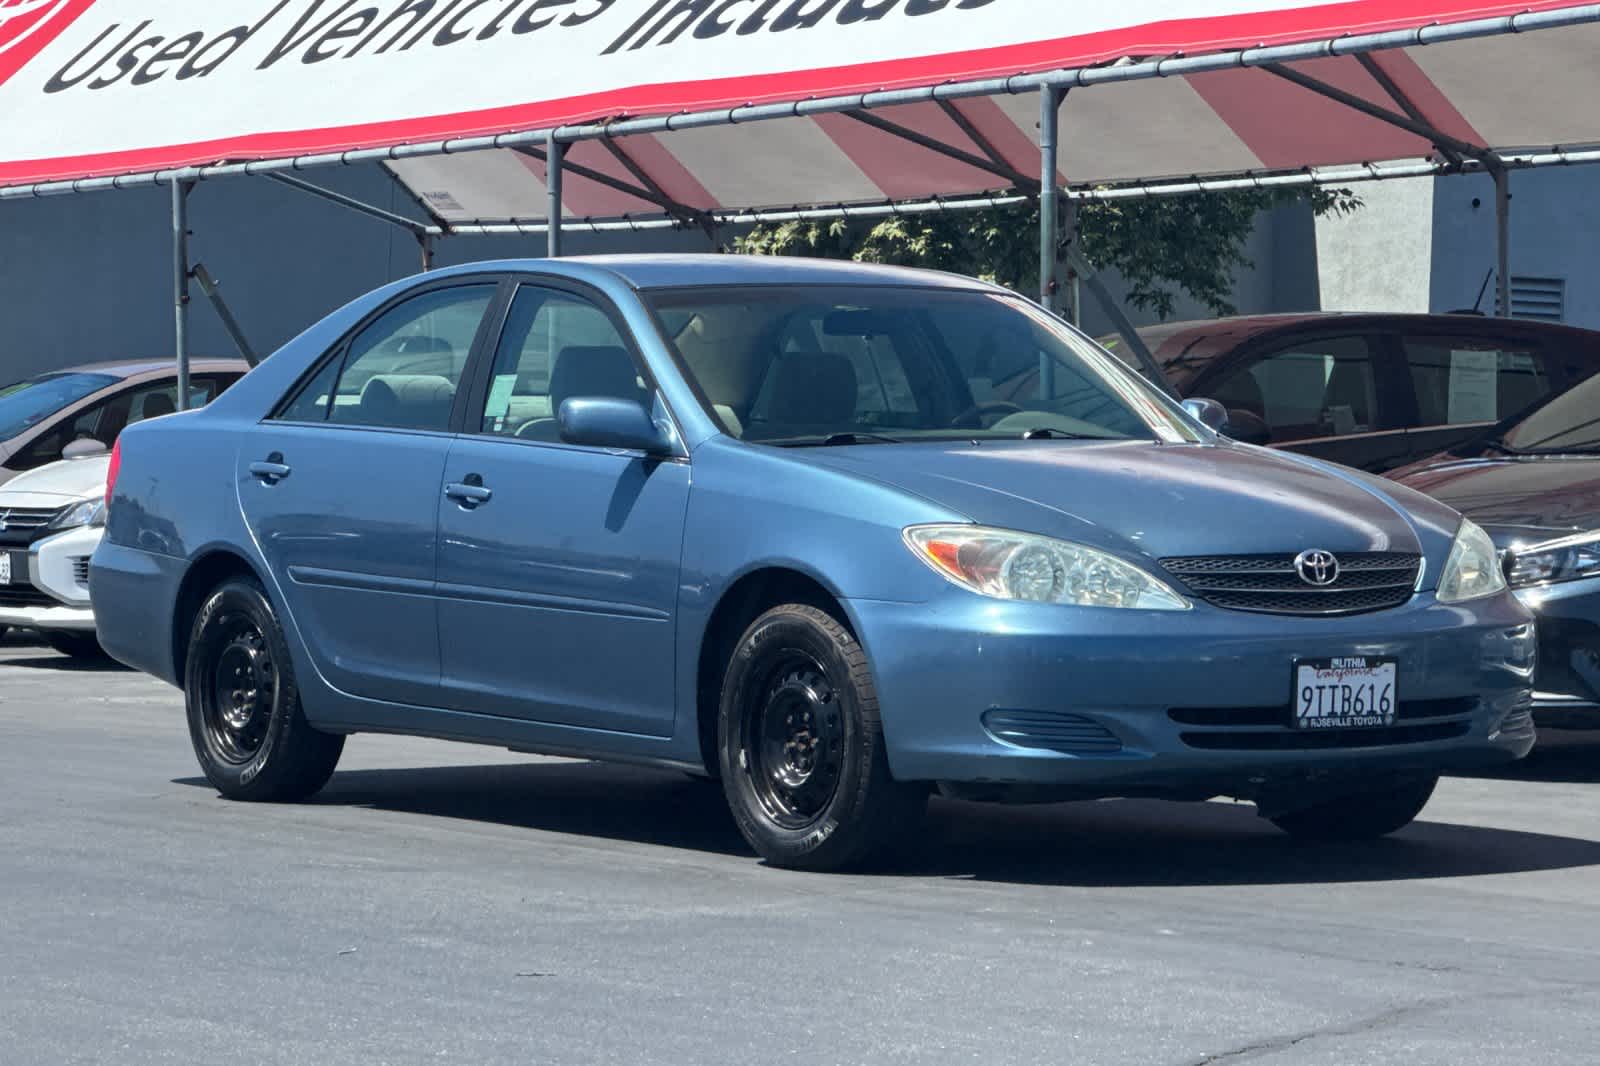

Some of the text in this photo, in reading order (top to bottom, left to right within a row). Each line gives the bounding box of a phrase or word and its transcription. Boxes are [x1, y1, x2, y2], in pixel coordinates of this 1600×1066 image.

[43, 0, 290, 93] Used
[1339, 657, 1367, 669] LITHIA
[1301, 682, 1392, 718] 9TIB616
[1310, 715, 1383, 728] ROSEVILLE TOYOTA
